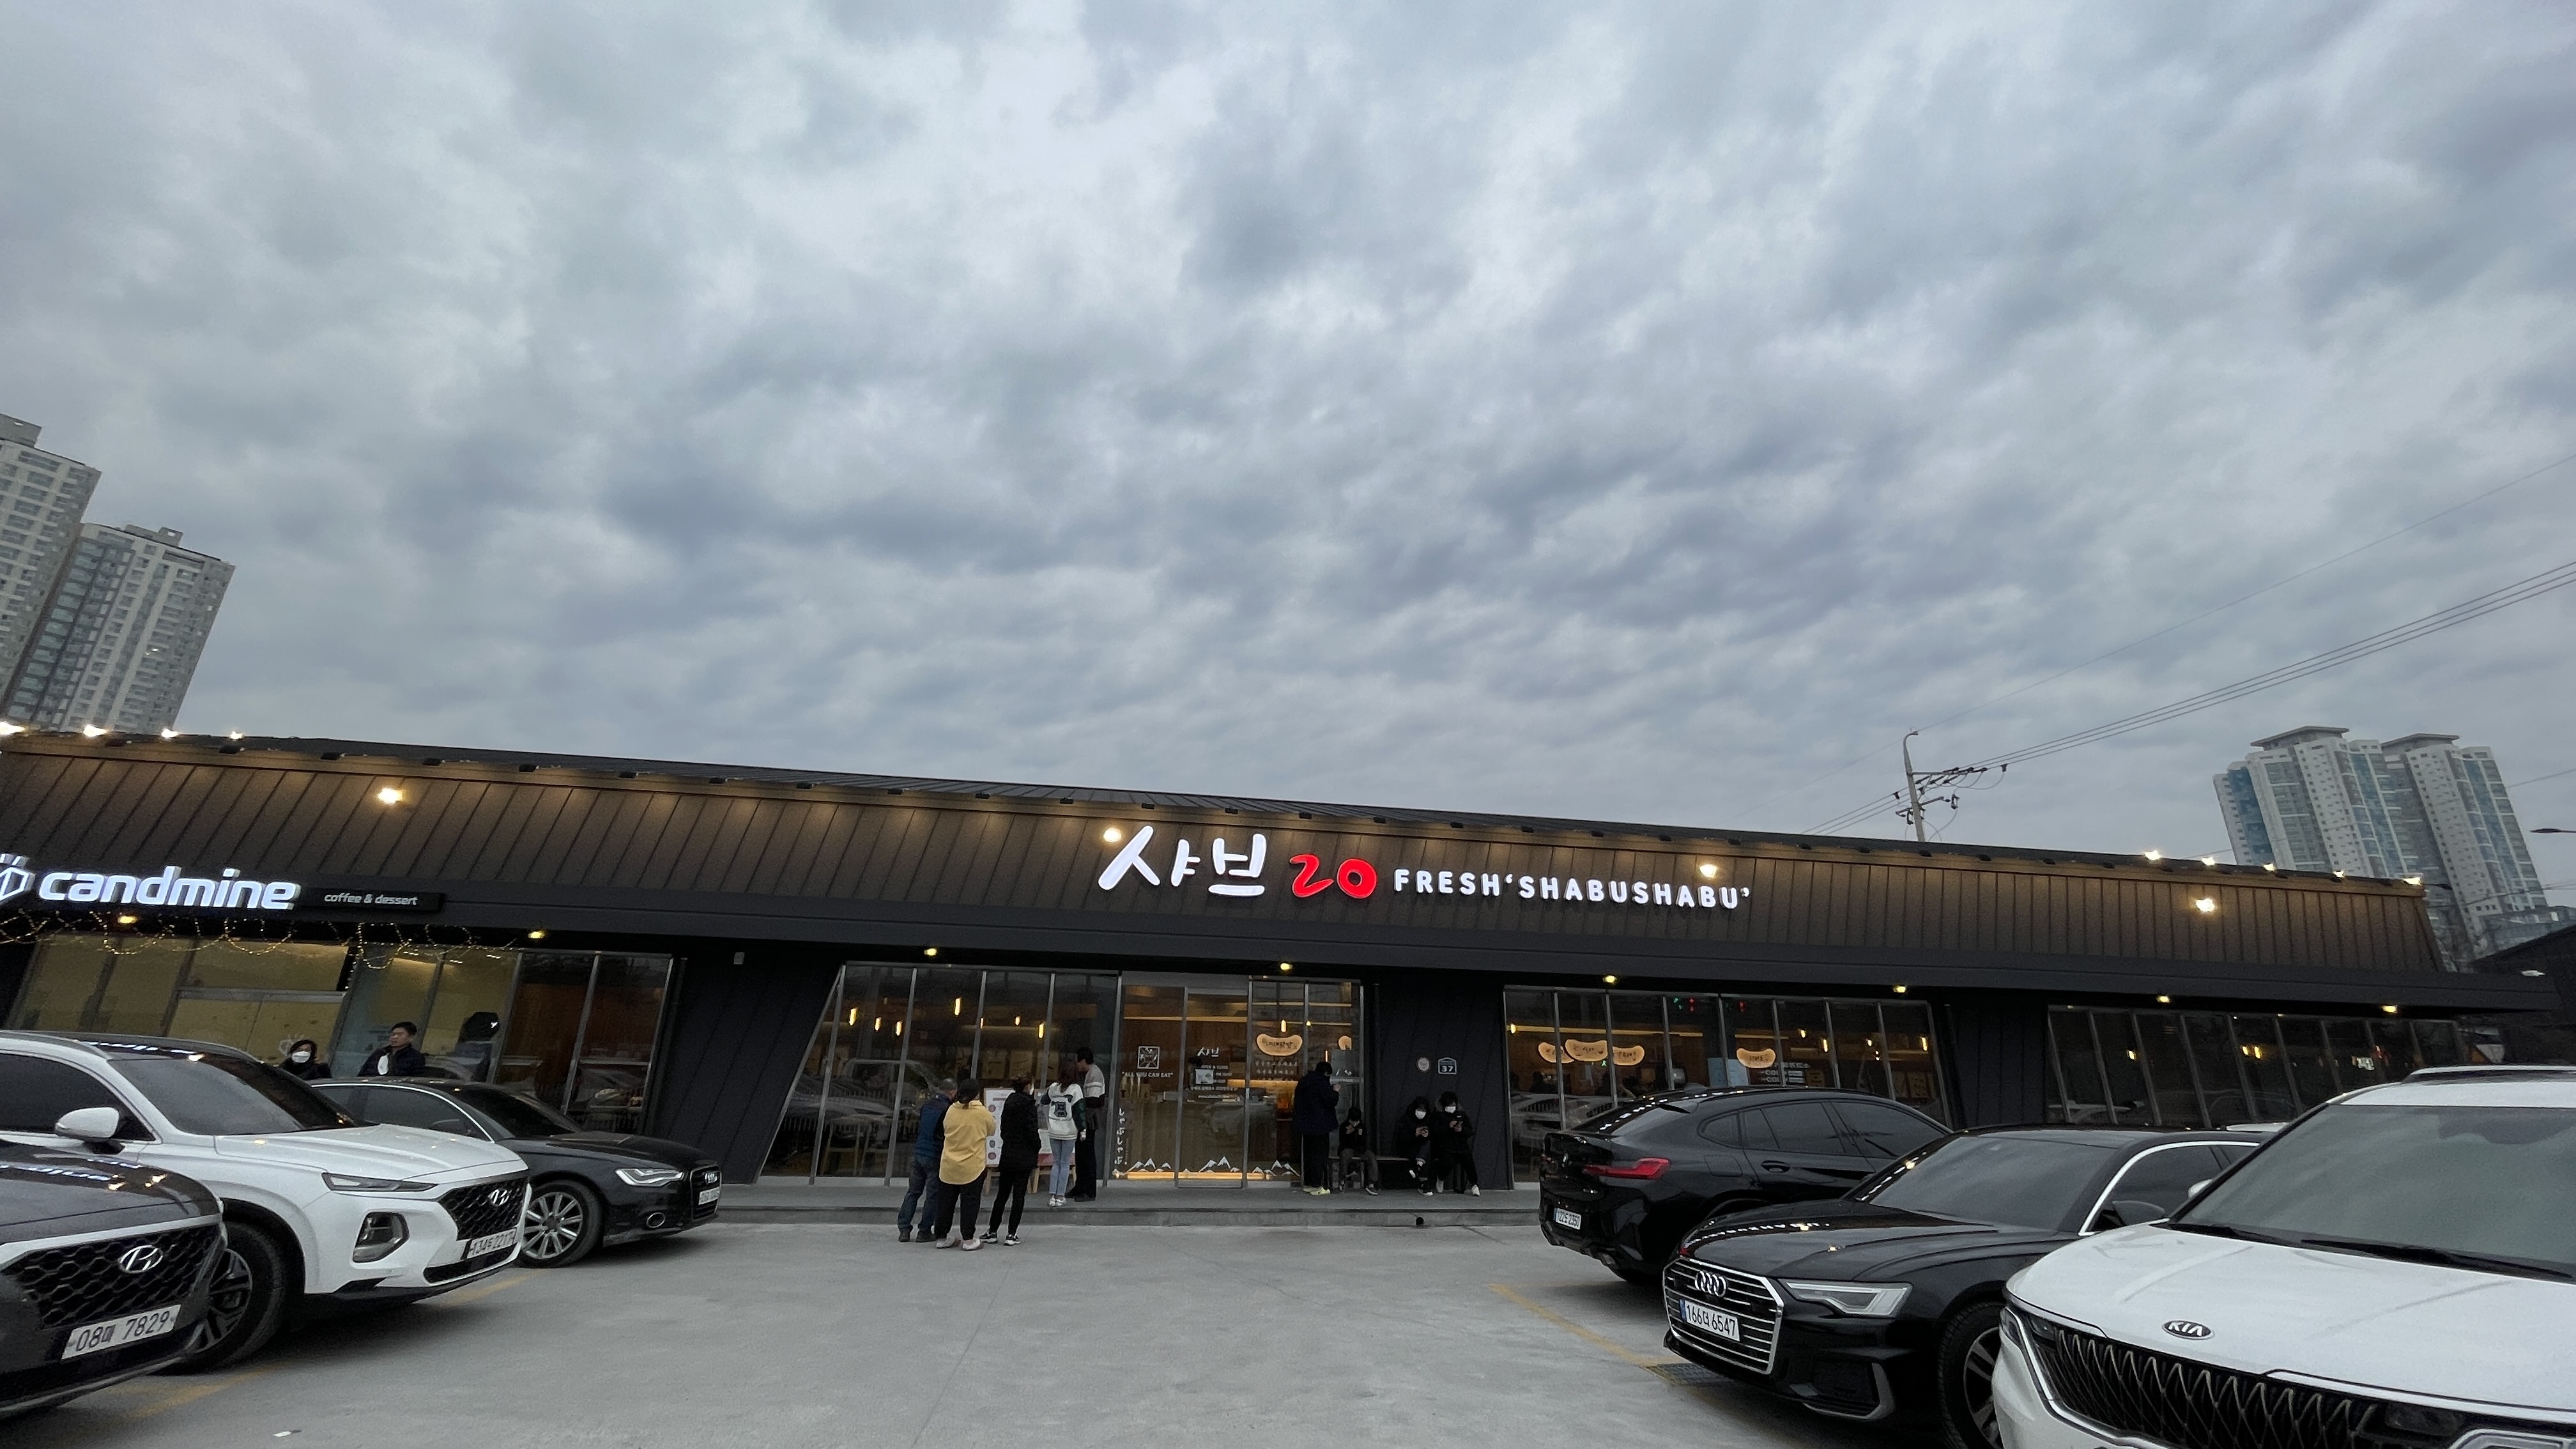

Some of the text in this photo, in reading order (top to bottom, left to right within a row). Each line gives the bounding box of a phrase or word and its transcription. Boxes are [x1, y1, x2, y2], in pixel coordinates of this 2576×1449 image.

[1098, 826, 1377, 898] 샤브 20
[39, 866, 301, 910] candmine
[325, 893, 418, 905] coffee & dessert
[121, 1310, 170, 1340] 7829
[1687, 1304, 1736, 1337] 166더 6547
[2168, 1321, 2203, 1337] KIA
